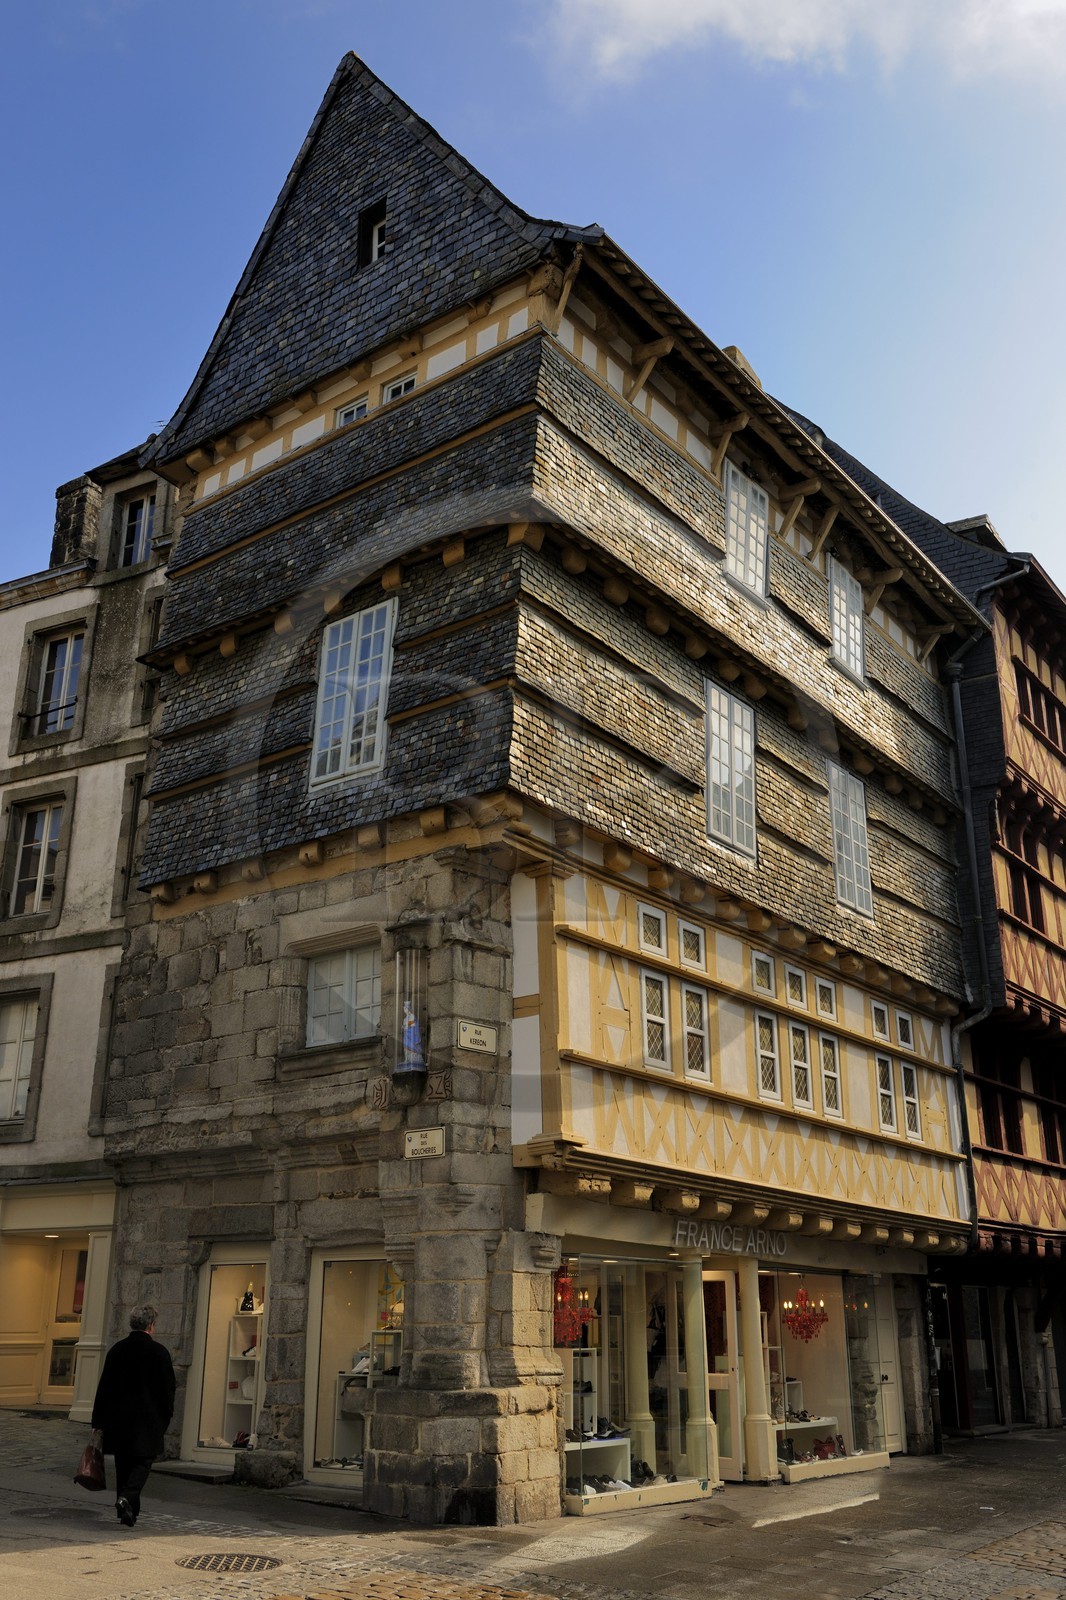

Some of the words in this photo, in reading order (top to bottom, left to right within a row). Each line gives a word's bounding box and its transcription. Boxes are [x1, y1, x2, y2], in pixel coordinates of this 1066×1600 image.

[411, 1146, 437, 1156] BOUCHERIES
[675, 1220, 743, 1252] FRANCE
[746, 1228, 787, 1256] ARNO
